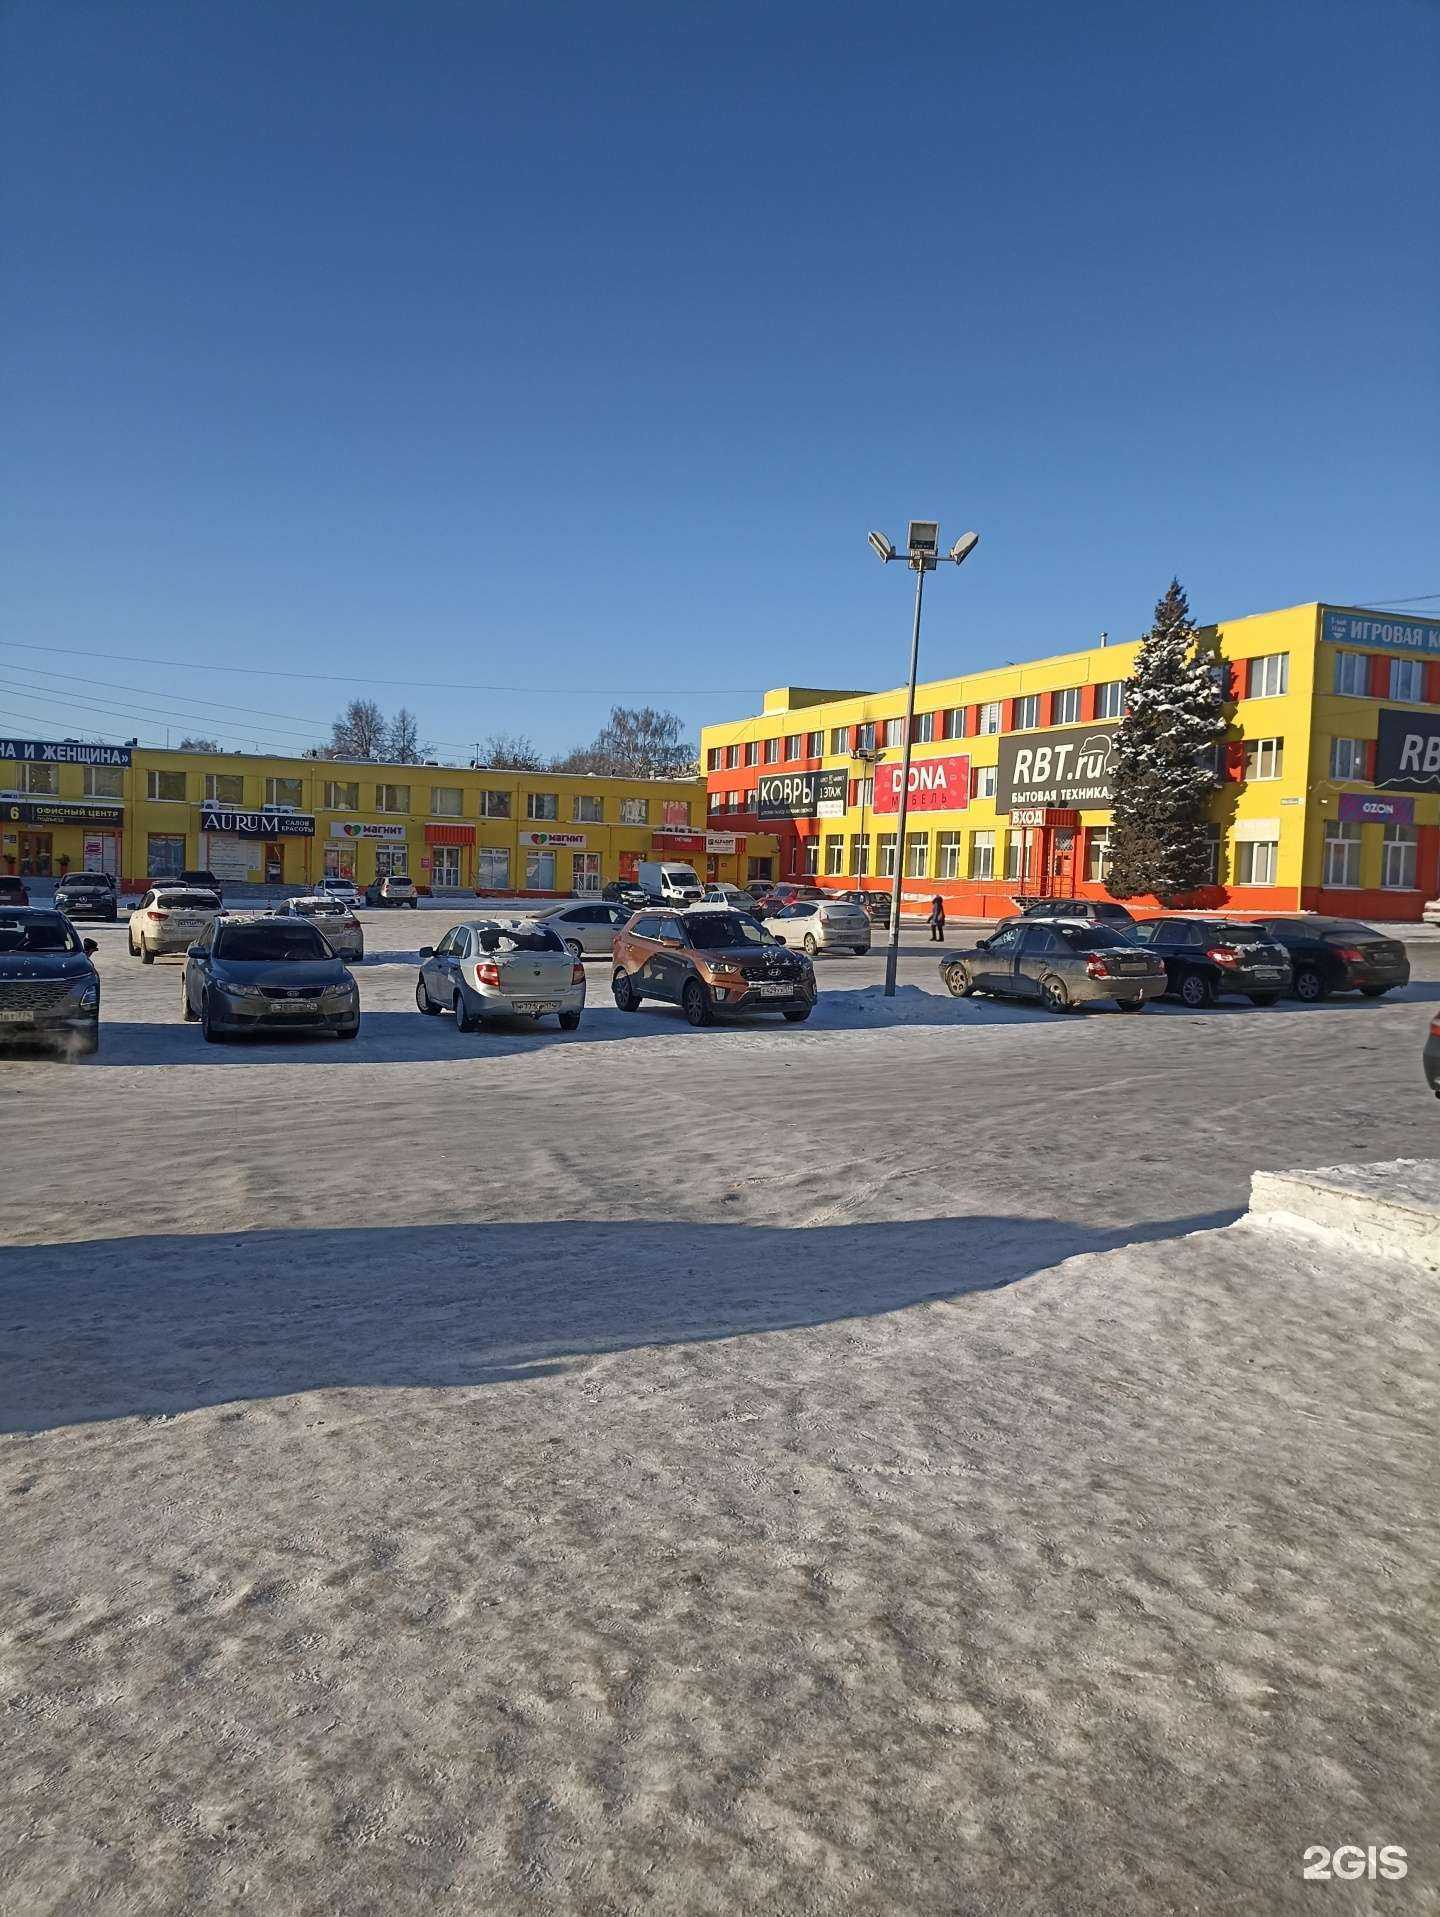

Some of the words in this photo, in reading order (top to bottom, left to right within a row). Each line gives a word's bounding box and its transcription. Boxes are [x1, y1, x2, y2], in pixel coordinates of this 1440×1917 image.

[1350, 619, 1424, 646] ИГРОВАЯ
[1428, 629, 1440, 648] К
[24, 743, 34, 759] И
[1399, 734, 1440, 772] RB
[1012, 743, 1104, 785] RBT.ru
[892, 764, 948, 793] DONA
[761, 776, 815, 806] КОВРЫ
[1011, 789, 1057, 803] БЫТОВАЯ
[1060, 786, 1109, 800] ТЕХНИКА
[891, 792, 947, 807] МБЕЛЬ
[10, 806, 20, 820] 6
[36, 807, 86, 816] ОФИСНЫЙ
[88, 809, 119, 817] ЦЕНТР
[1362, 802, 1395, 814] OZON
[204, 814, 280, 832] AURUM
[1012, 810, 1043, 825] ВХОД
[281, 826, 314, 834] КРАСОТЫ
